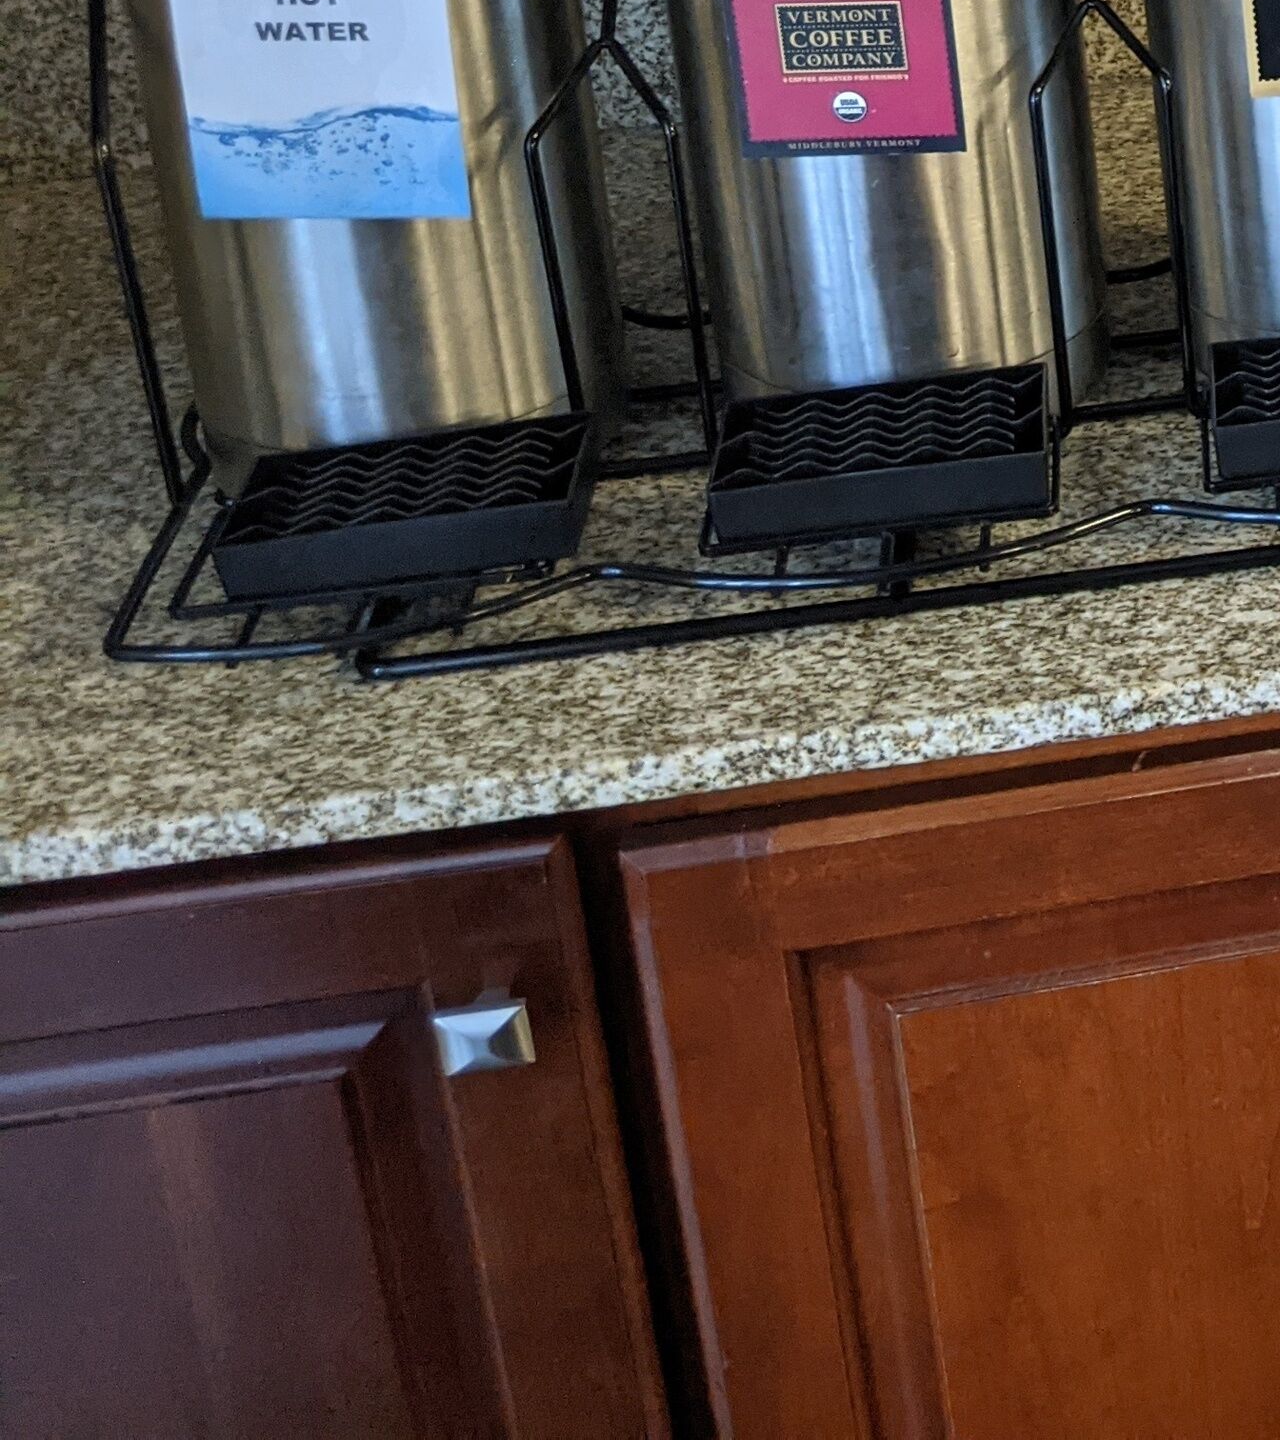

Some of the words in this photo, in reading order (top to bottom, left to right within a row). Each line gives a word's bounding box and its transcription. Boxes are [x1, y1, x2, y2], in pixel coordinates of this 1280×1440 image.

[786, 8, 891, 23] VERMONT
[255, 22, 370, 41] WATER
[789, 28, 895, 47] COFFEE
[792, 52, 897, 67] COMPANY
[866, 139, 921, 148] VERMONT
